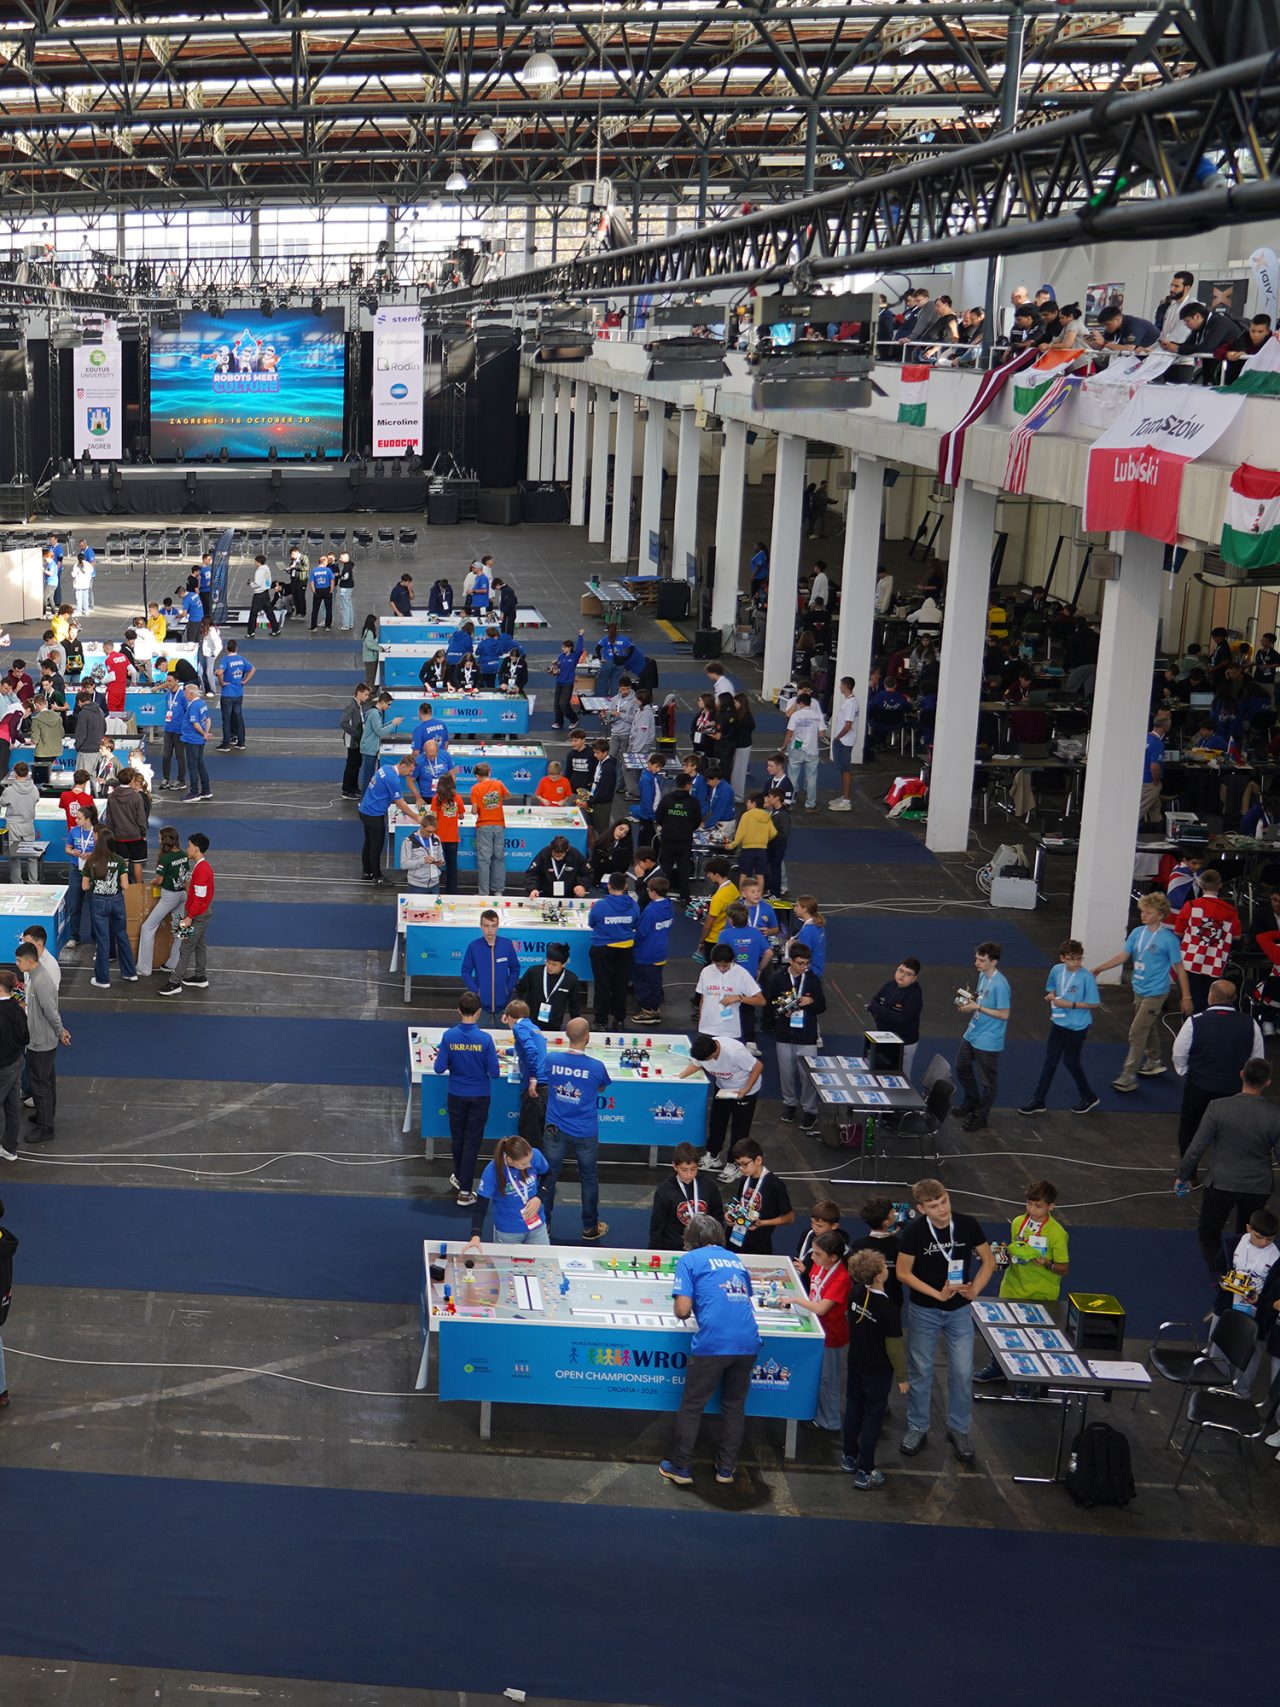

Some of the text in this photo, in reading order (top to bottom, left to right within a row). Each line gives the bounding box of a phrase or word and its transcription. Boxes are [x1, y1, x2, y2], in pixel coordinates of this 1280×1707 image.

[214, 374, 252, 382] ROBOTS
[214, 381, 279, 393] CULTURE
[377, 418, 419, 426] Microline
[457, 708, 478, 717] WRO
[426, 724, 444, 734] JUDGE
[667, 808, 688, 817] INDIA
[503, 838, 520, 849] RO
[706, 985, 733, 993] LEBAON
[449, 1043, 483, 1053] UKRAINE
[552, 1064, 590, 1079] JUDGE
[632, 1349, 687, 1370] WRO
[555, 1369, 584, 1380] OPEN
[586, 1371, 665, 1384] CHAMPIONSHIP
[607, 1385, 636, 1394] CROATIA
